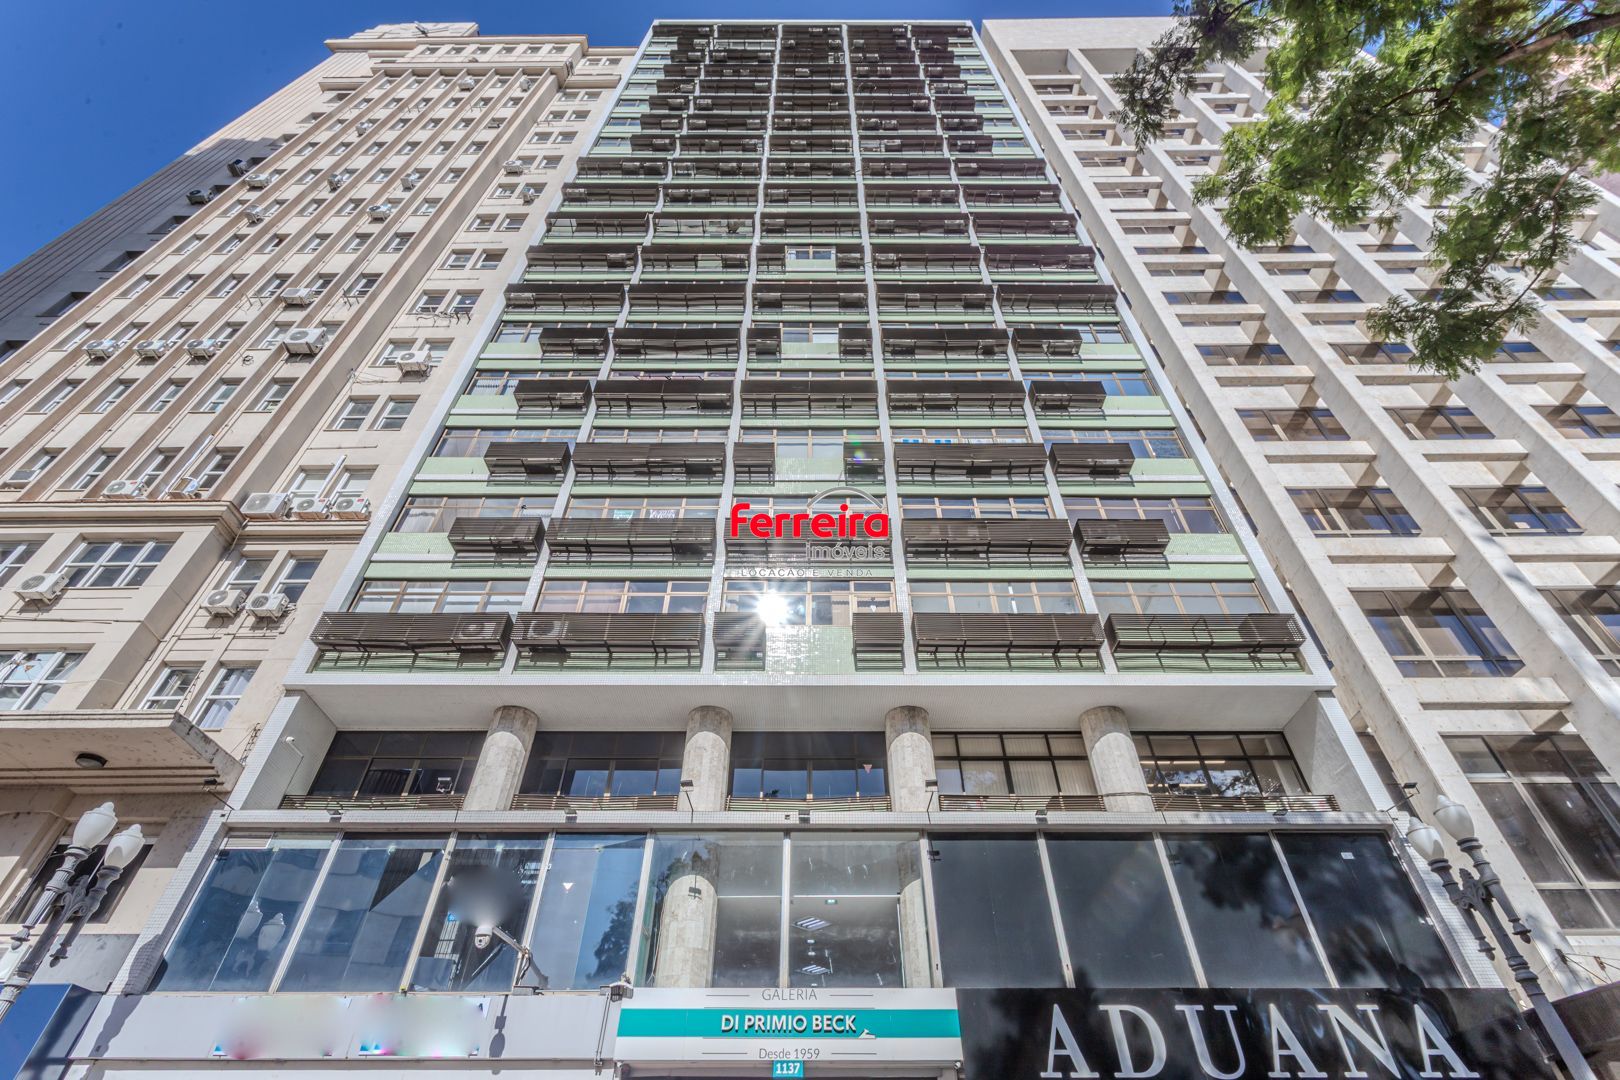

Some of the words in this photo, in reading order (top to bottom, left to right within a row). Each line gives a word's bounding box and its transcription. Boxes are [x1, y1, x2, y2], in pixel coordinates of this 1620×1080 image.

[762, 988, 818, 1001] GALERIA
[721, 1015, 739, 1032] DI
[744, 1015, 807, 1033] PRIMIO
[812, 1015, 857, 1032] BECK
[1040, 1003, 1480, 1080] ADUANA
[759, 1048, 791, 1059] Desde
[794, 1048, 820, 1060] 1959
[776, 1063, 800, 1075] 1137
